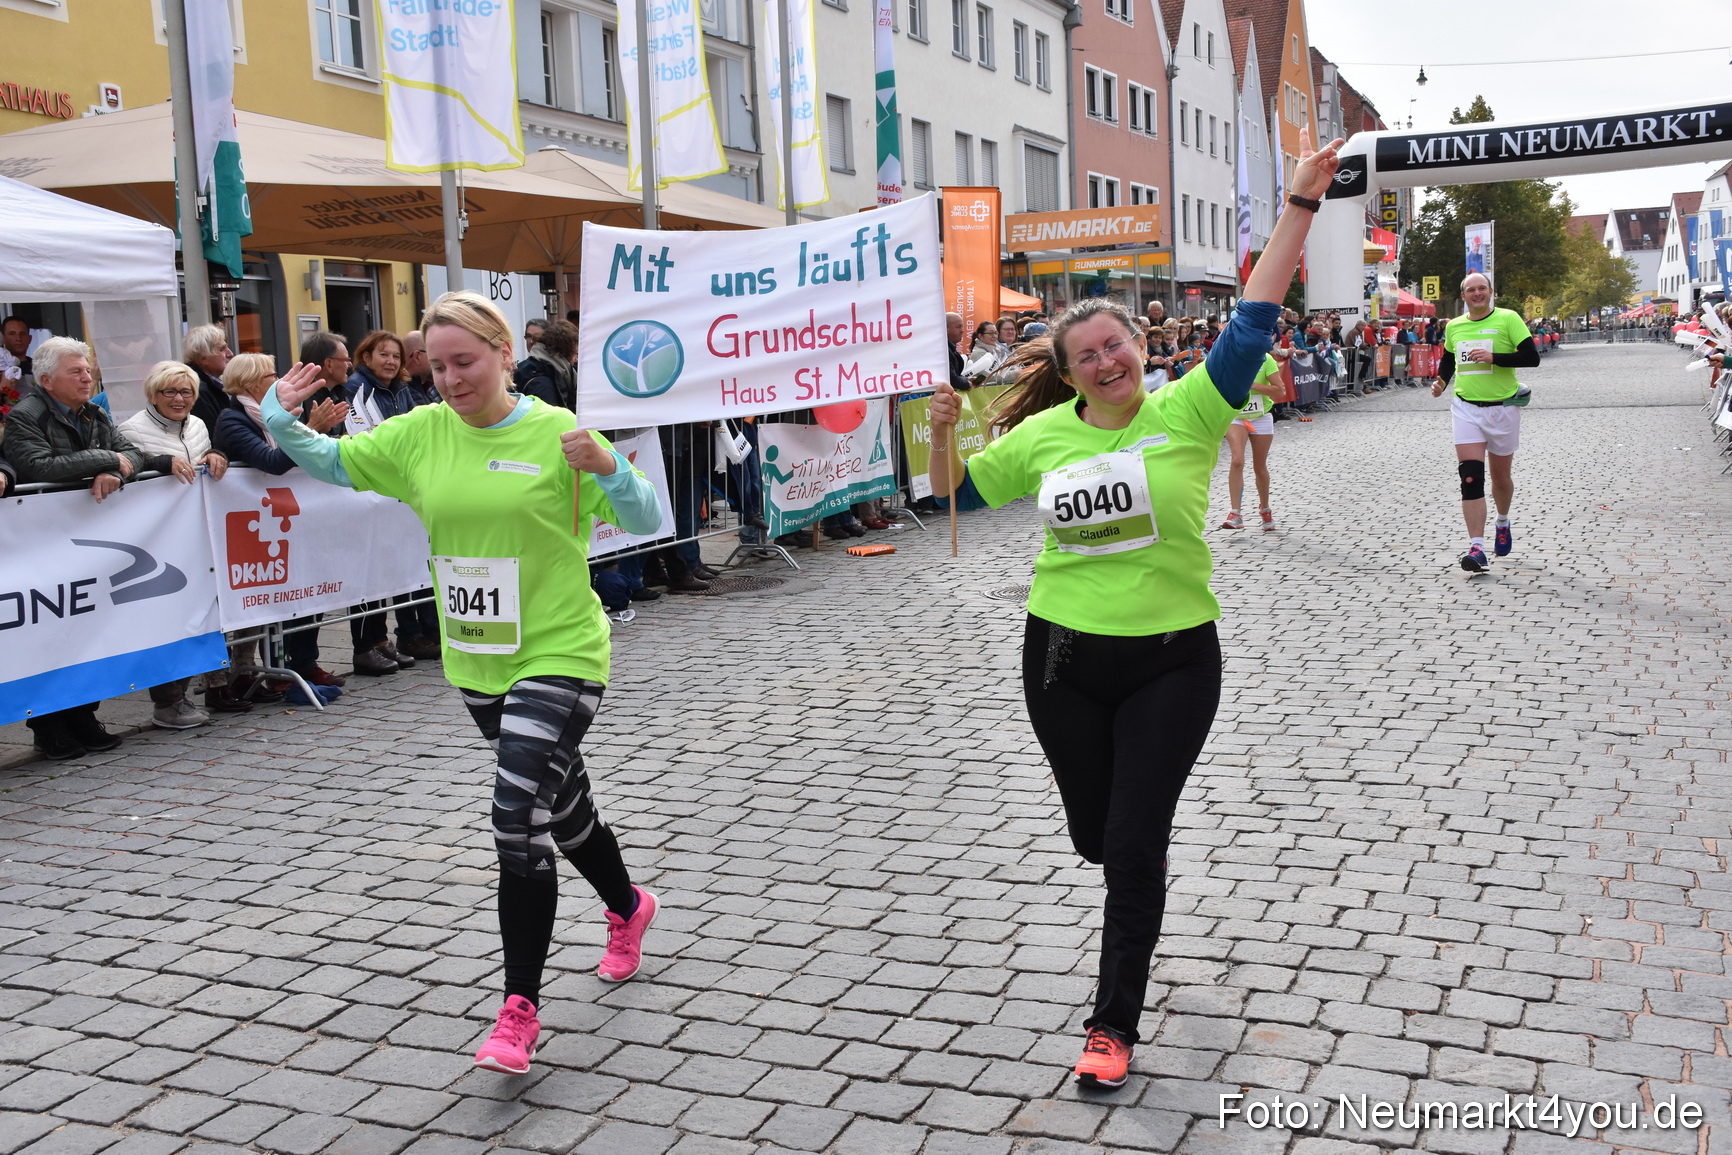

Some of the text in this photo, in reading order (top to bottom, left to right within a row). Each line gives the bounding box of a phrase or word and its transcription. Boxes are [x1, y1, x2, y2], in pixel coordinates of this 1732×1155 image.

[390, 24, 460, 52] Stadt!
[1407, 109, 1724, 165] MINI NEUMARKT.
[607, 222, 918, 297] Mit uns läufts
[397, 282, 410, 296] 24
[1426, 284, 1436, 295] B
[706, 299, 914, 359] Grundschule
[720, 362, 934, 407] Haus St. Marien
[1054, 481, 1133, 522] 5040
[596, 529, 614, 543] JEDER
[1079, 525, 1120, 540] Claudia
[231, 558, 286, 587] DKMS
[458, 566, 490, 575] BOCK
[242, 581, 343, 611] JEDER EINZELNE ZÄHLT
[448, 585, 500, 616] 5041
[460, 625, 484, 637] Maria
